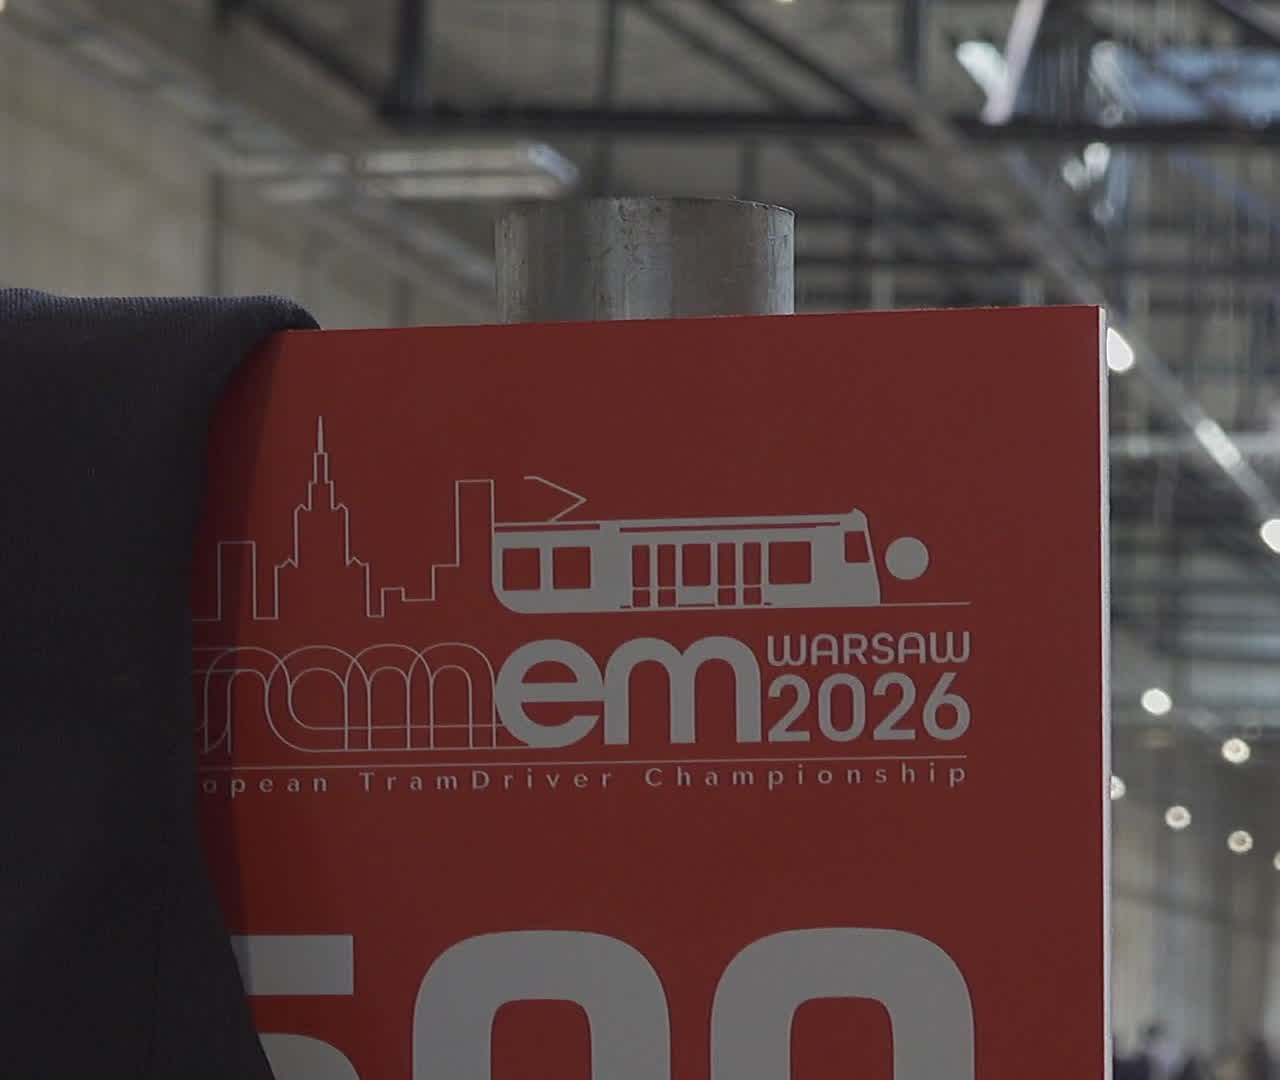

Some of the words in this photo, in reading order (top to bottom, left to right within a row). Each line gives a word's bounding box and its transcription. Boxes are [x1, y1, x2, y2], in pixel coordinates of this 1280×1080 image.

[767, 631, 971, 667] WARSAW
[767, 671, 971, 743] 2026
[201, 772, 330, 798] opean
[358, 768, 613, 793] TramDriver
[644, 763, 967, 789] Championship
